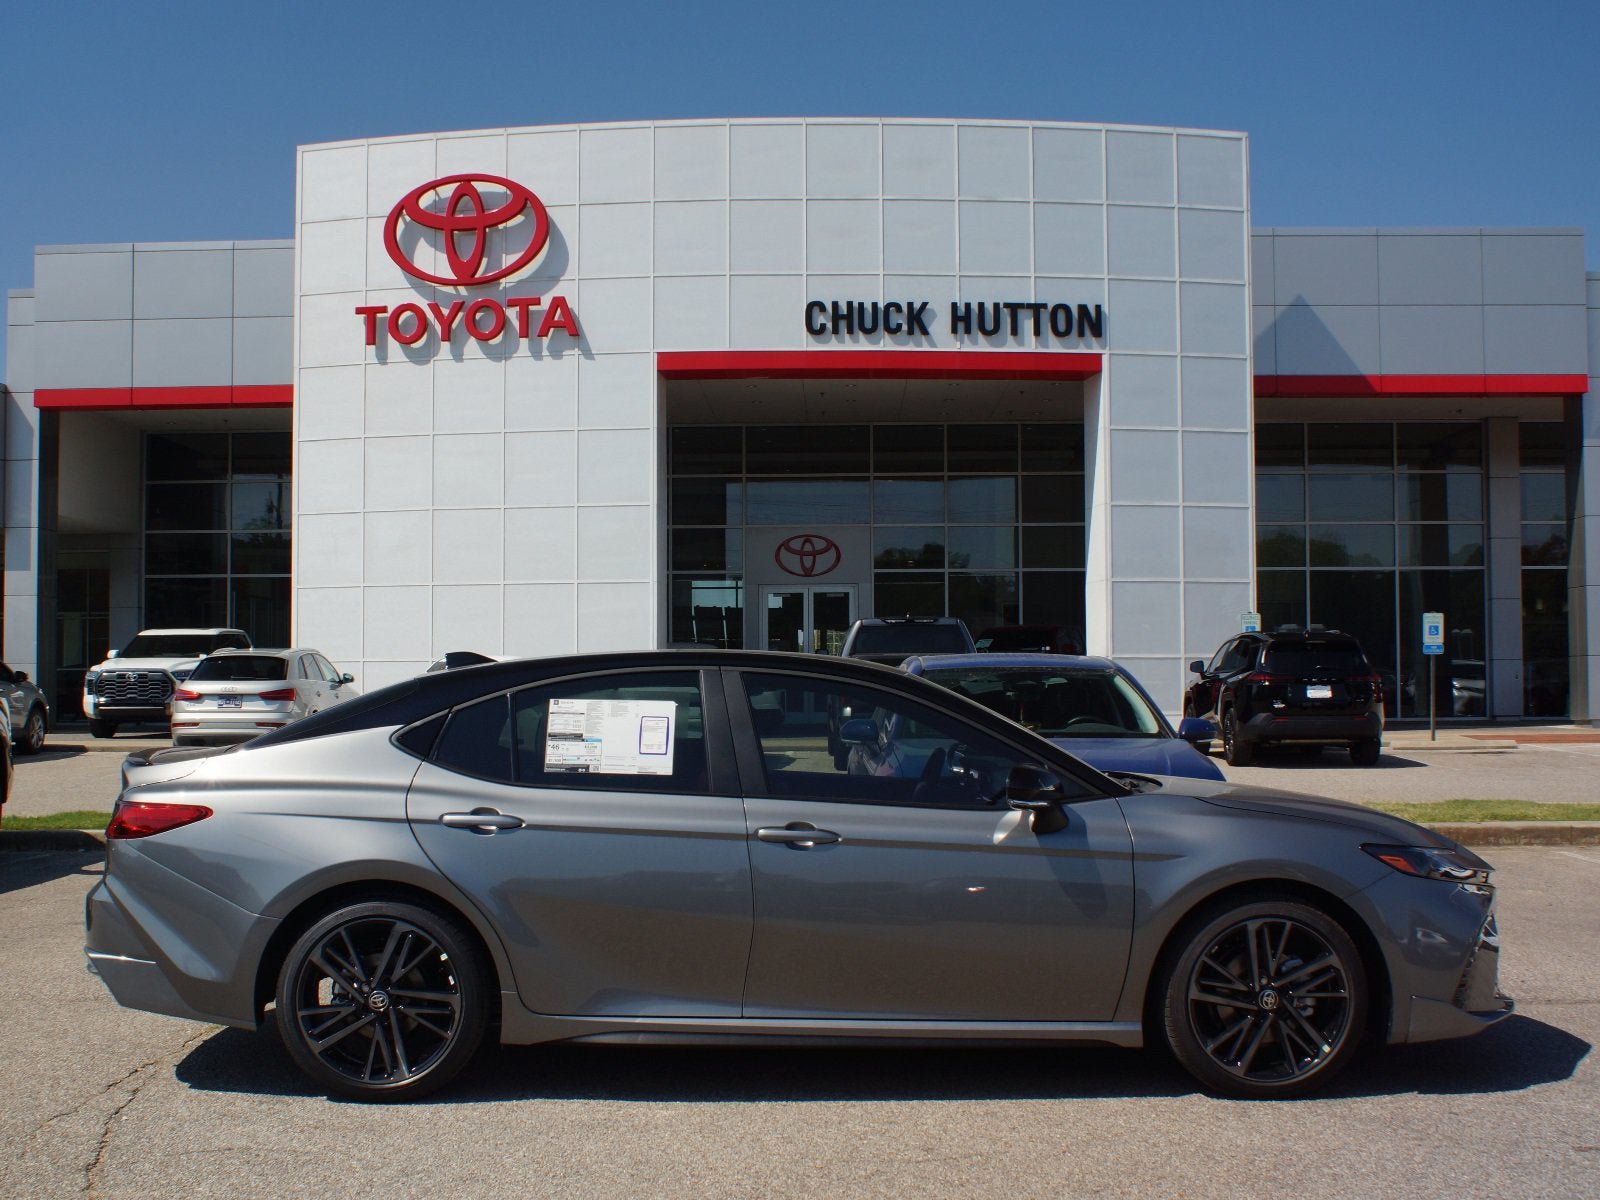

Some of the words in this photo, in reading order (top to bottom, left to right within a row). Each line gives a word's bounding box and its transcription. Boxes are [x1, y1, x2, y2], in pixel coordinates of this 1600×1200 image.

[355, 296, 580, 345] TOYOTA
[805, 300, 930, 336] CHUCK
[951, 301, 1103, 338] HUTTON
